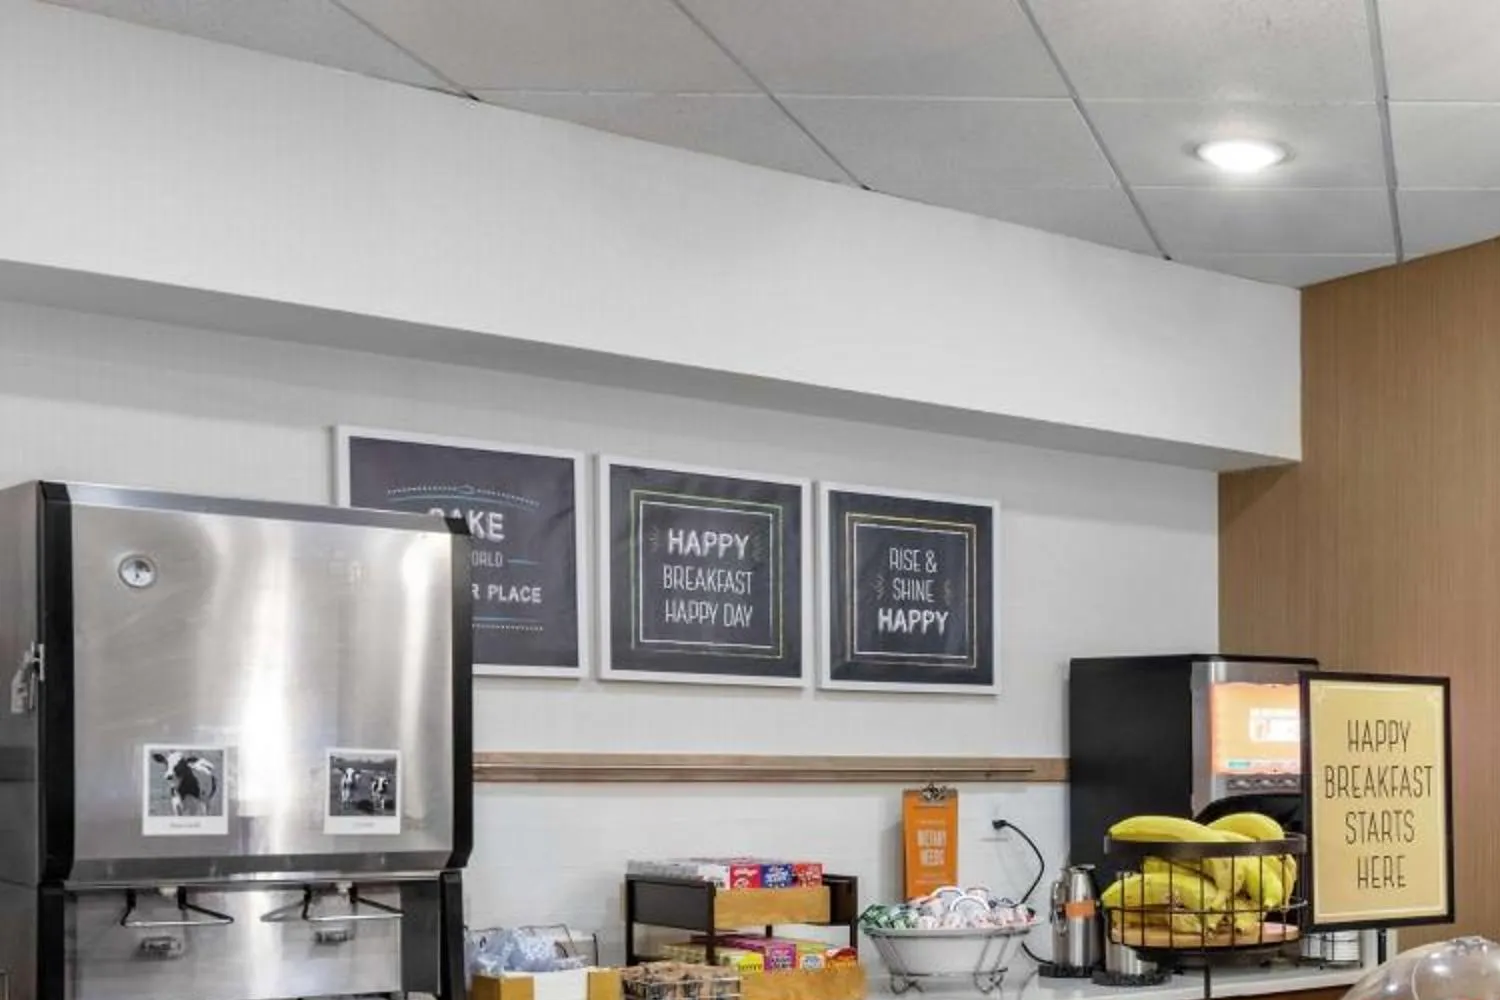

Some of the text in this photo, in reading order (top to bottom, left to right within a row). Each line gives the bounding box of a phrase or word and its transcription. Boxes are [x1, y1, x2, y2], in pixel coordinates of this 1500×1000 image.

[429, 507, 505, 542] KE
[471, 551, 503, 568] ORLD
[667, 527, 749, 560] HAPPY
[889, 547, 938, 573] RISE &
[487, 584, 542, 604] PLACE
[663, 564, 753, 596] BREAKFAST
[892, 577, 935, 603] SHINE
[665, 600, 753, 628] HAPPY DAY
[878, 607, 949, 636] HAPPY
[1347, 719, 1411, 752] HAPPY
[1324, 765, 1433, 799] BREAKFAST
[1345, 809, 1415, 845] STARTS
[1357, 855, 1407, 889] HERE
